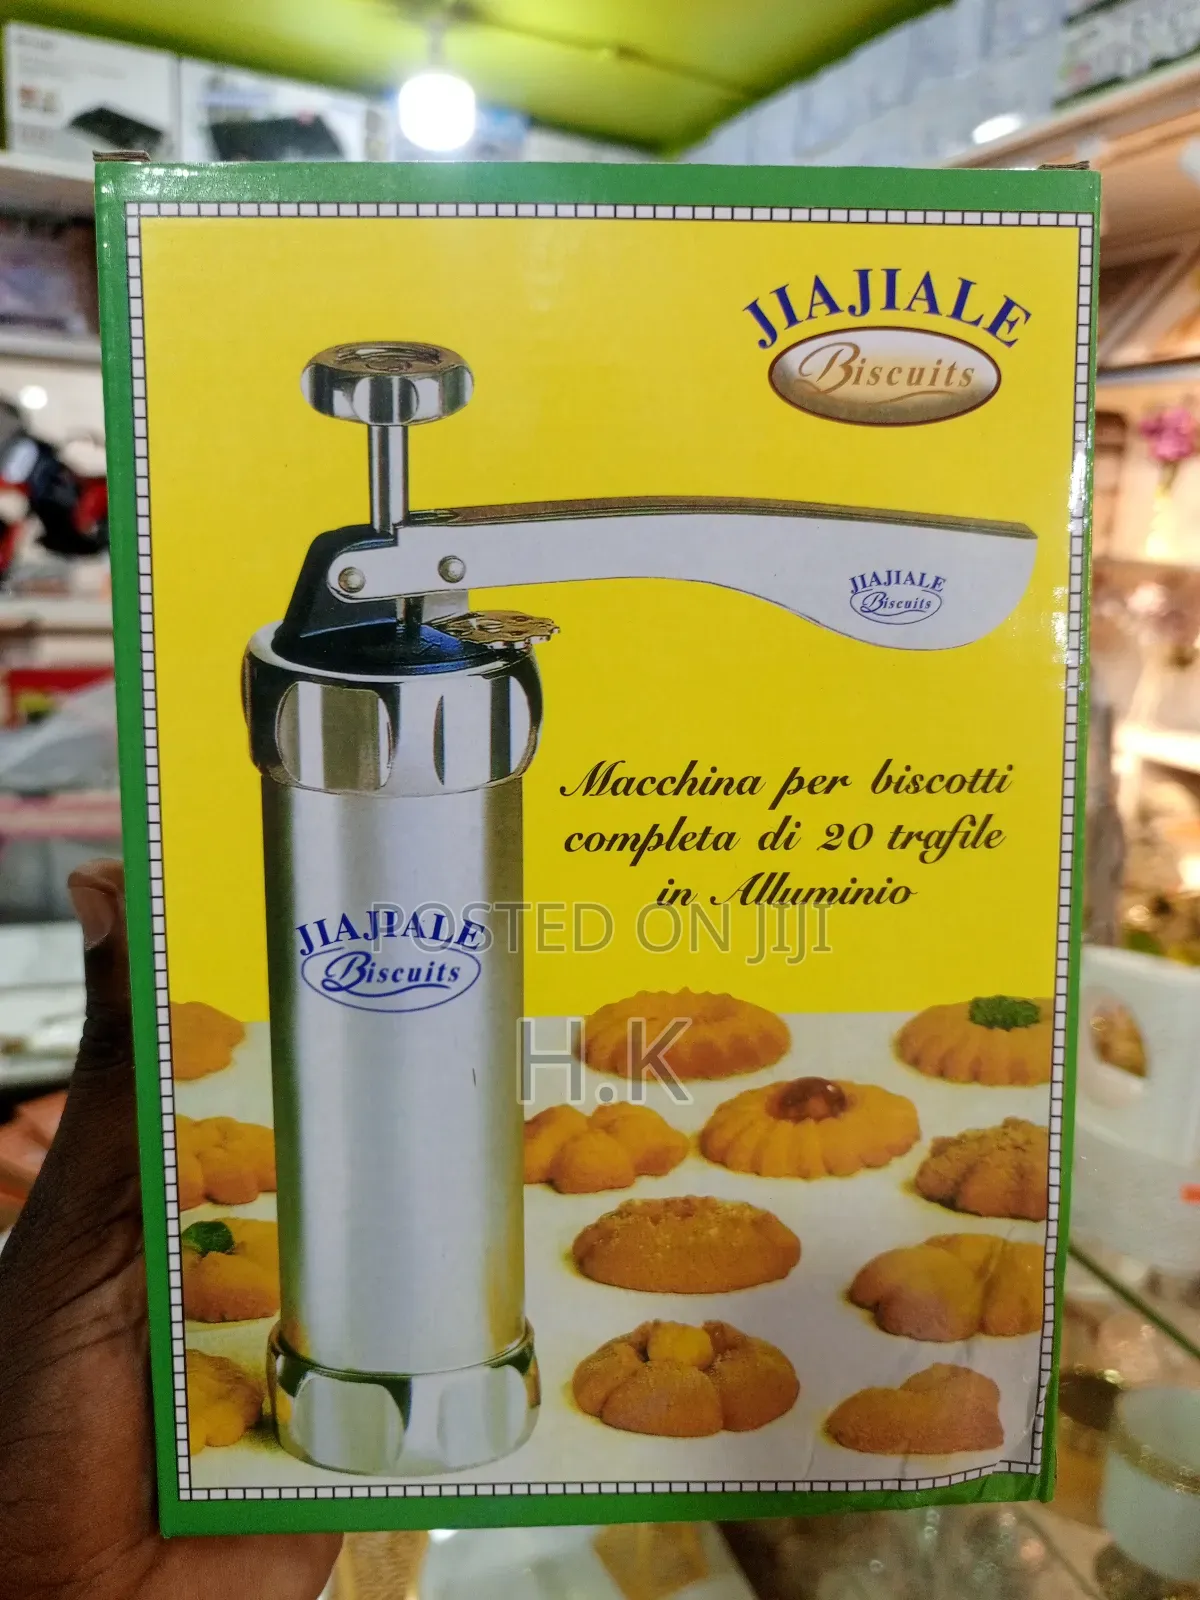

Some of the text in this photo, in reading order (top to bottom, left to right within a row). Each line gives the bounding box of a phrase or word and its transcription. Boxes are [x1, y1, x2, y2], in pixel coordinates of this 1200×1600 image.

[742, 268, 1032, 349] JIAJIALE
[794, 341, 975, 404] Biscuits
[848, 569, 947, 594] JIAJIALE
[860, 591, 932, 616] Biscuits
[559, 758, 1014, 811] Macchina per biscotti
[563, 813, 1007, 867] completa di 20 trafile
[656, 871, 918, 907] in Alluminio
[296, 911, 485, 956] JIAJIALE
[321, 951, 461, 997] Biscuits
